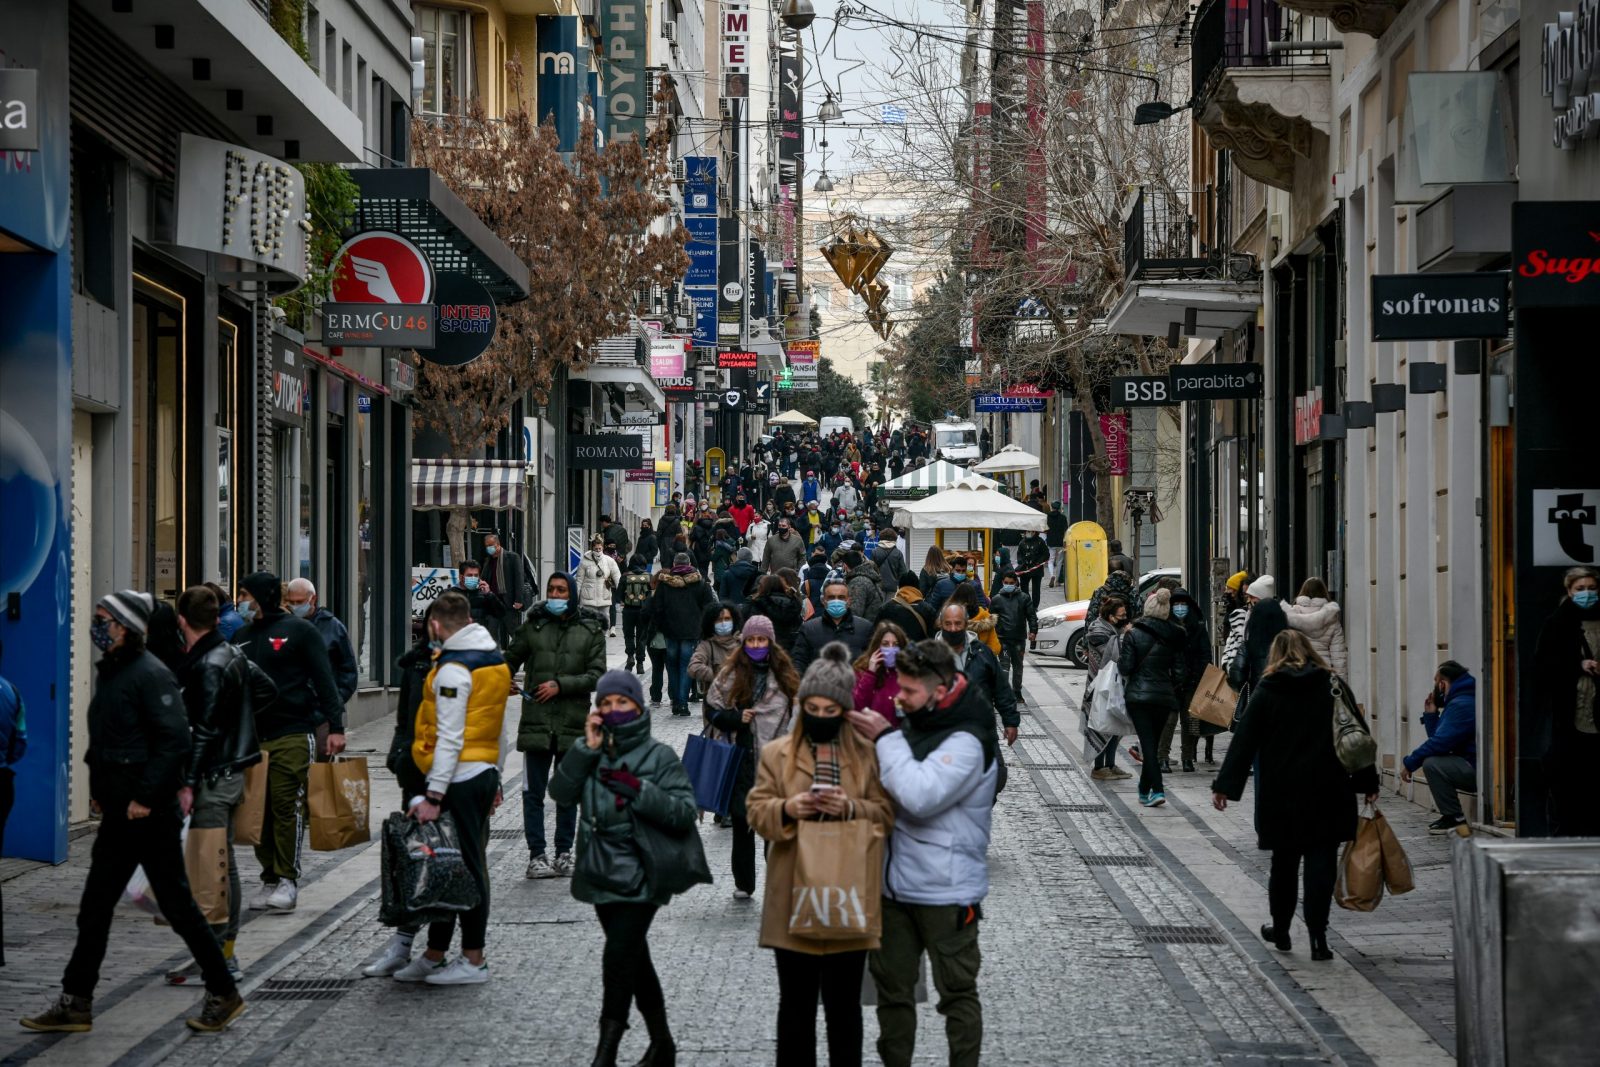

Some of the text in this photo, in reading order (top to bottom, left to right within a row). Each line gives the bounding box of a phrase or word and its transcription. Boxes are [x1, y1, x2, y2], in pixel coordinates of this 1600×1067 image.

[440, 304, 492, 319] INTER
[1382, 292, 1501, 315] sofronas
[439, 318, 491, 334] SPORT
[1124, 381, 1168, 402] BSB
[1177, 371, 1244, 392] parabita
[576, 446, 640, 458] ROMANO
[789, 886, 866, 928] ZARA
